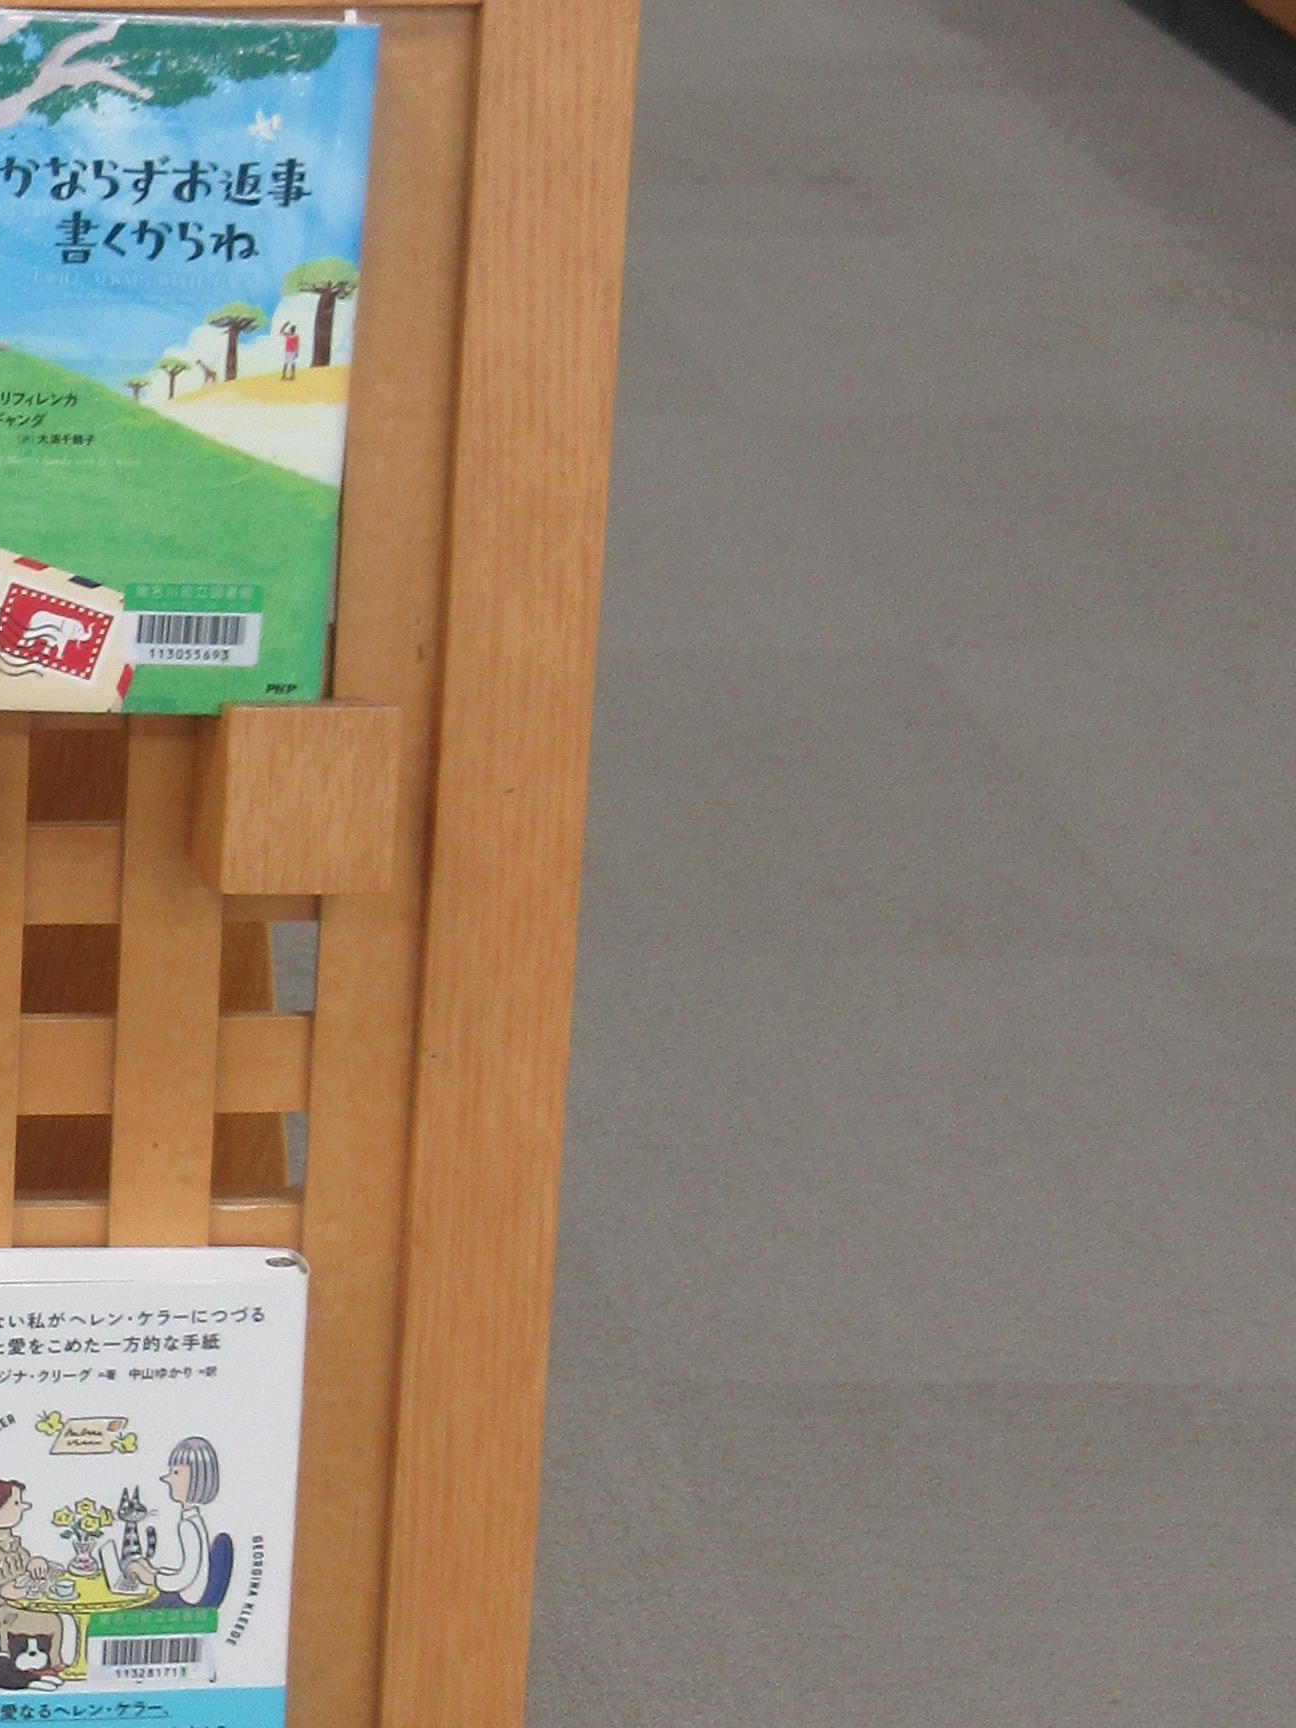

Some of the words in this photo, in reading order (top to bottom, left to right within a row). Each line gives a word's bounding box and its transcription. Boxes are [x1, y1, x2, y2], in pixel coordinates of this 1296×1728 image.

[54, 209, 260, 265] 書くからね
[149, 648, 230, 661] 113055693
